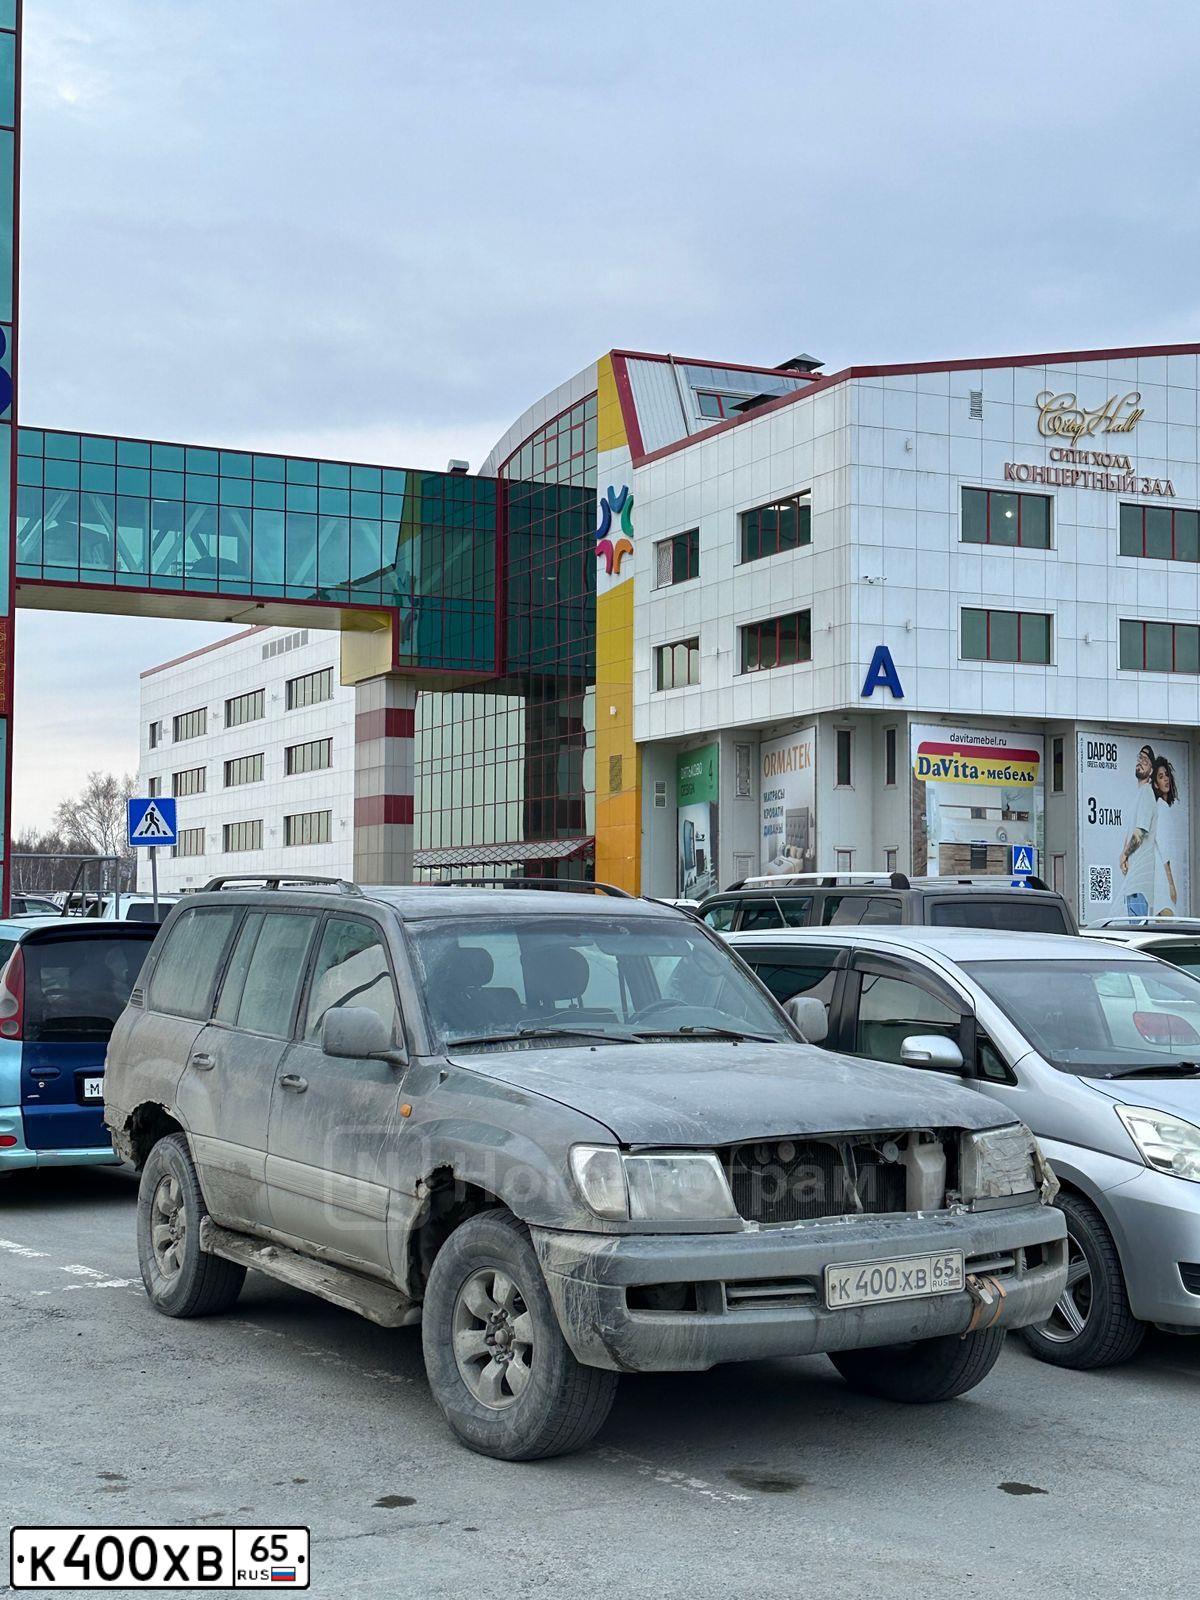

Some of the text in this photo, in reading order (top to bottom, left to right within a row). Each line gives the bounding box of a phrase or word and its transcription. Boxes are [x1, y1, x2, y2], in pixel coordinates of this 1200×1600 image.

[1087, 391, 1145, 438] Hall
[1050, 447, 1132, 470] СИТИ ХОЛЛ
[1004, 462, 1177, 498] КОНЦЕРТНЫЙ ЗАЛ
[949, 733, 1007, 747] davitamebel.ru
[763, 742, 811, 778] ORMATEK
[1088, 796, 1122, 826] 3 ЭТАЖ
[839, 1257, 954, 1300] К400ХВ 65
[932, 1279, 948, 1287] RUS
